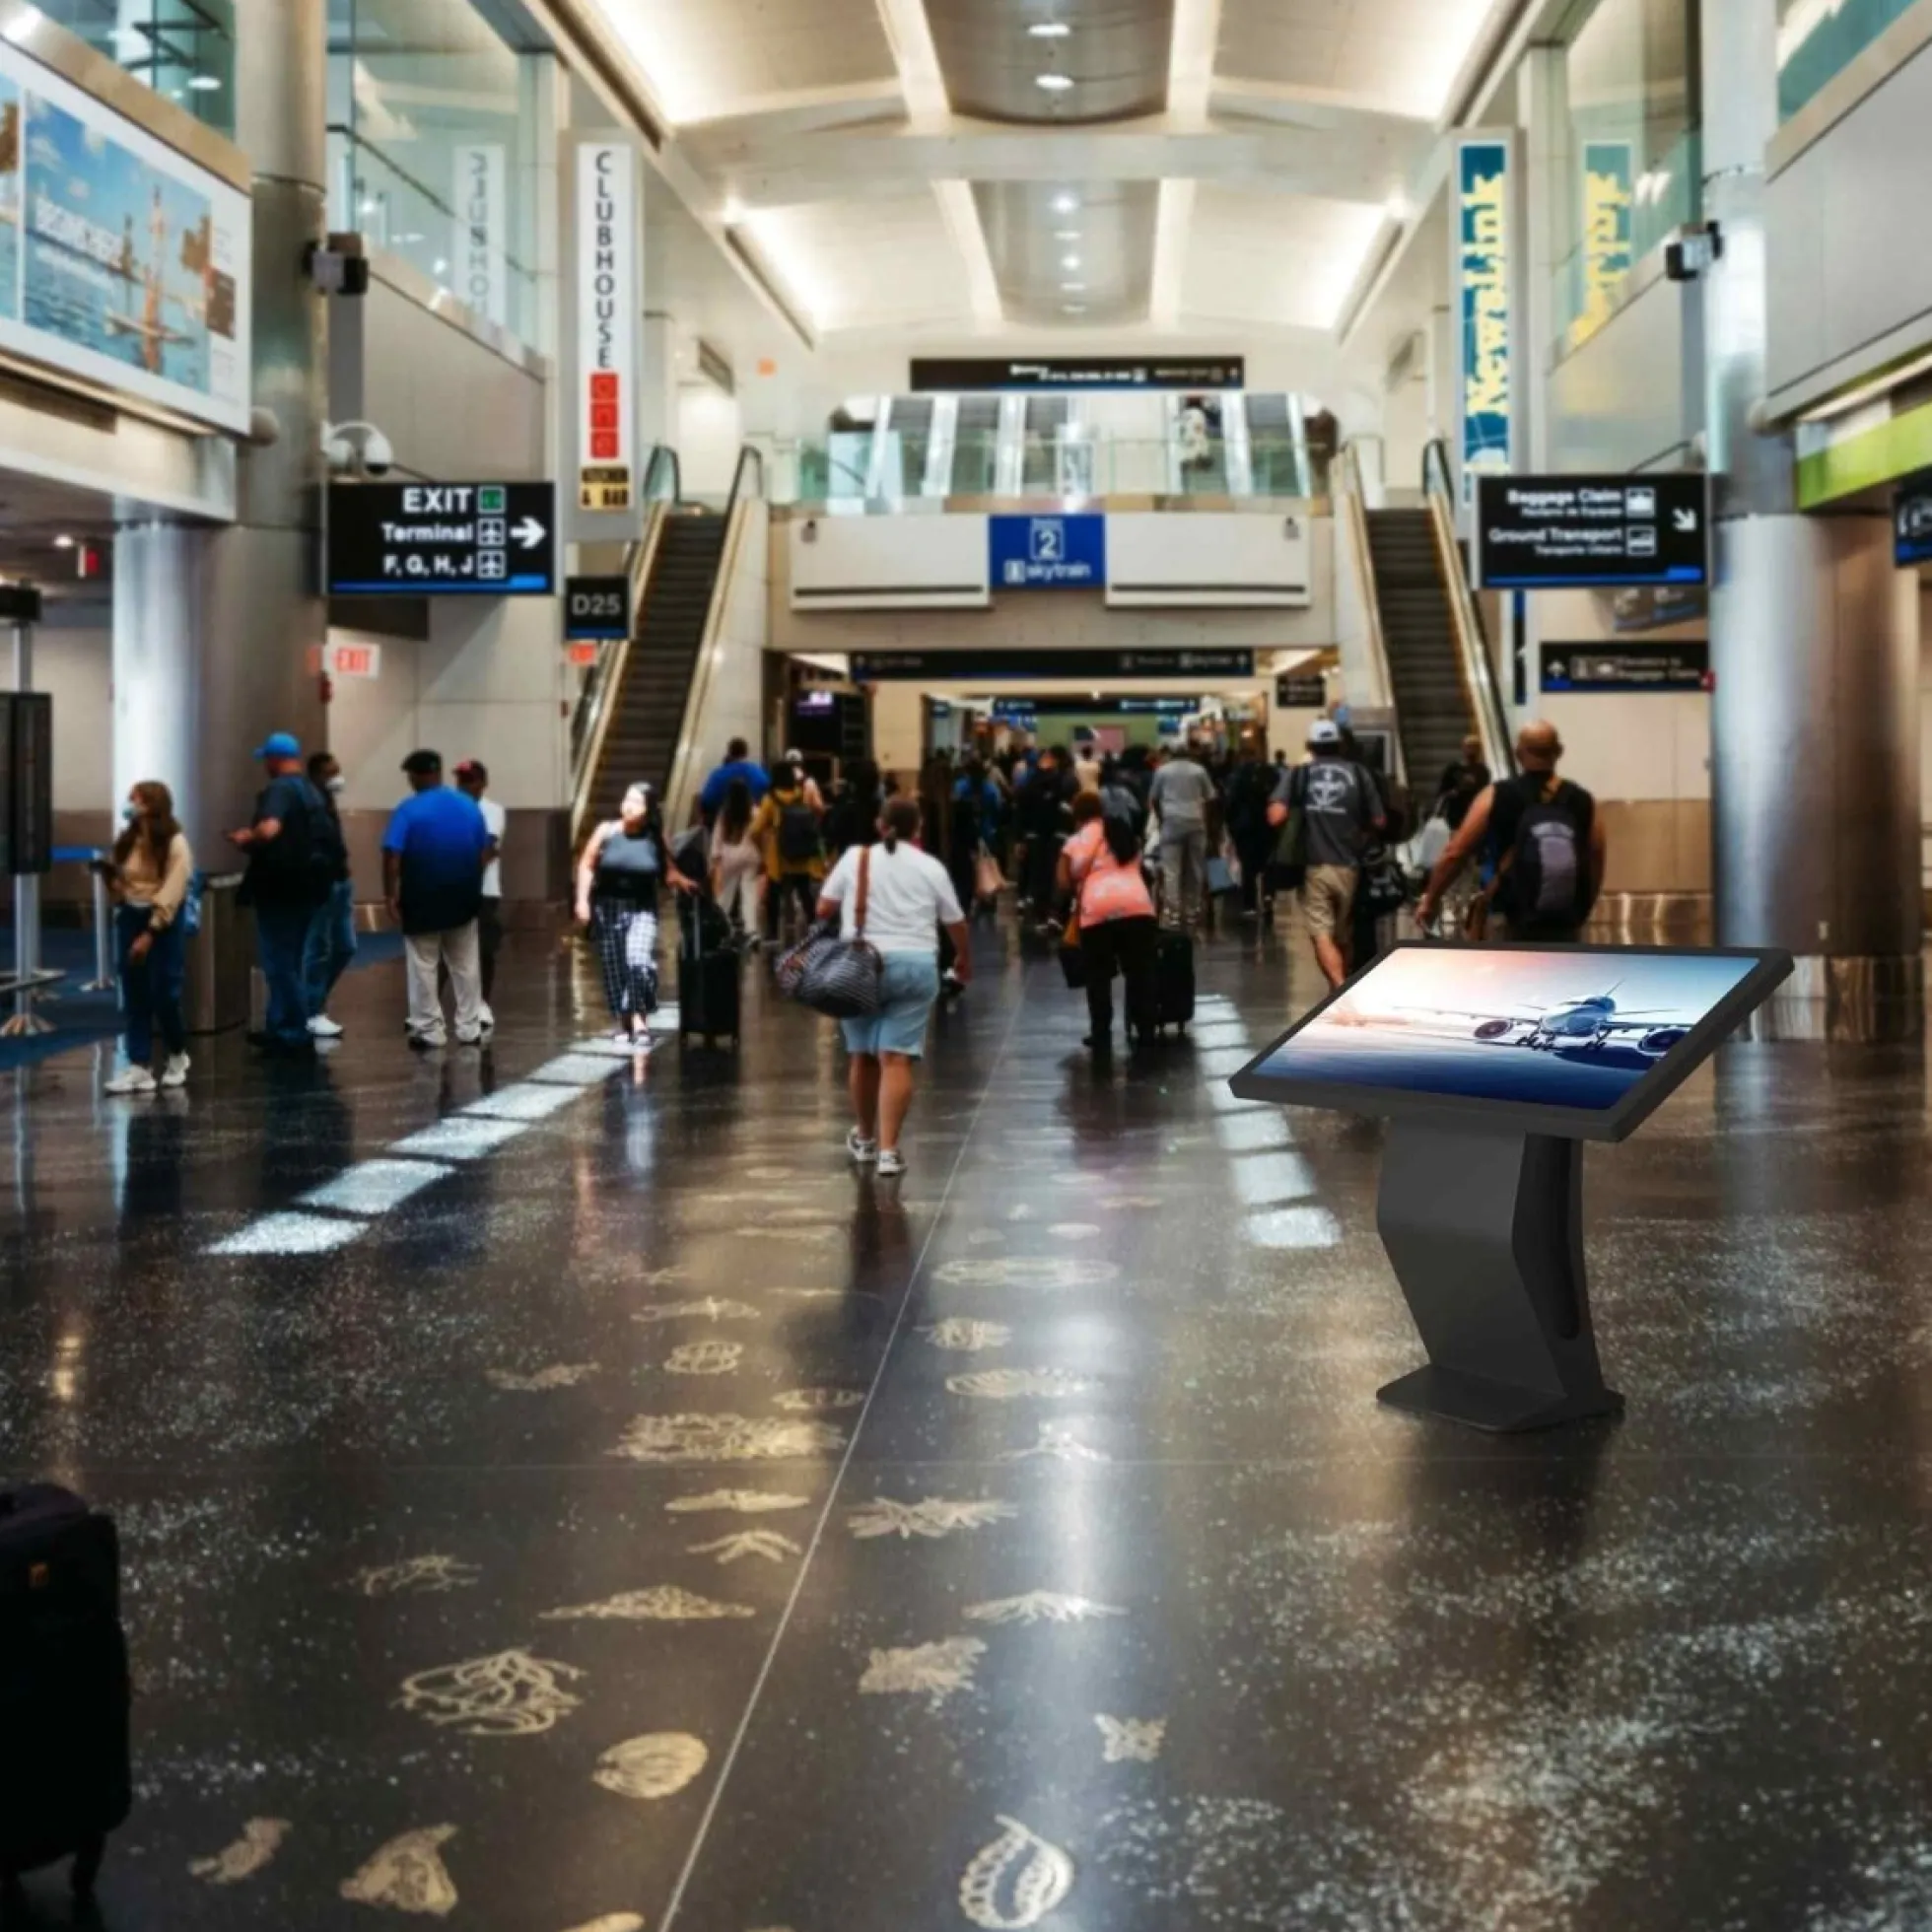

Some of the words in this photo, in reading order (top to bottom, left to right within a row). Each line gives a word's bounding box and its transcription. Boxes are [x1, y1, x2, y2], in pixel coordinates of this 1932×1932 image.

[594, 151, 615, 368] CLUBHOUSE
[403, 487, 473, 513] EXIT
[380, 521, 473, 541] Terminal
[1488, 527, 1547, 542] Ground
[1550, 527, 1622, 544] Transport
[1038, 530, 1057, 559] 2
[460, 555, 473, 574] J
[572, 593, 621, 615] D25
